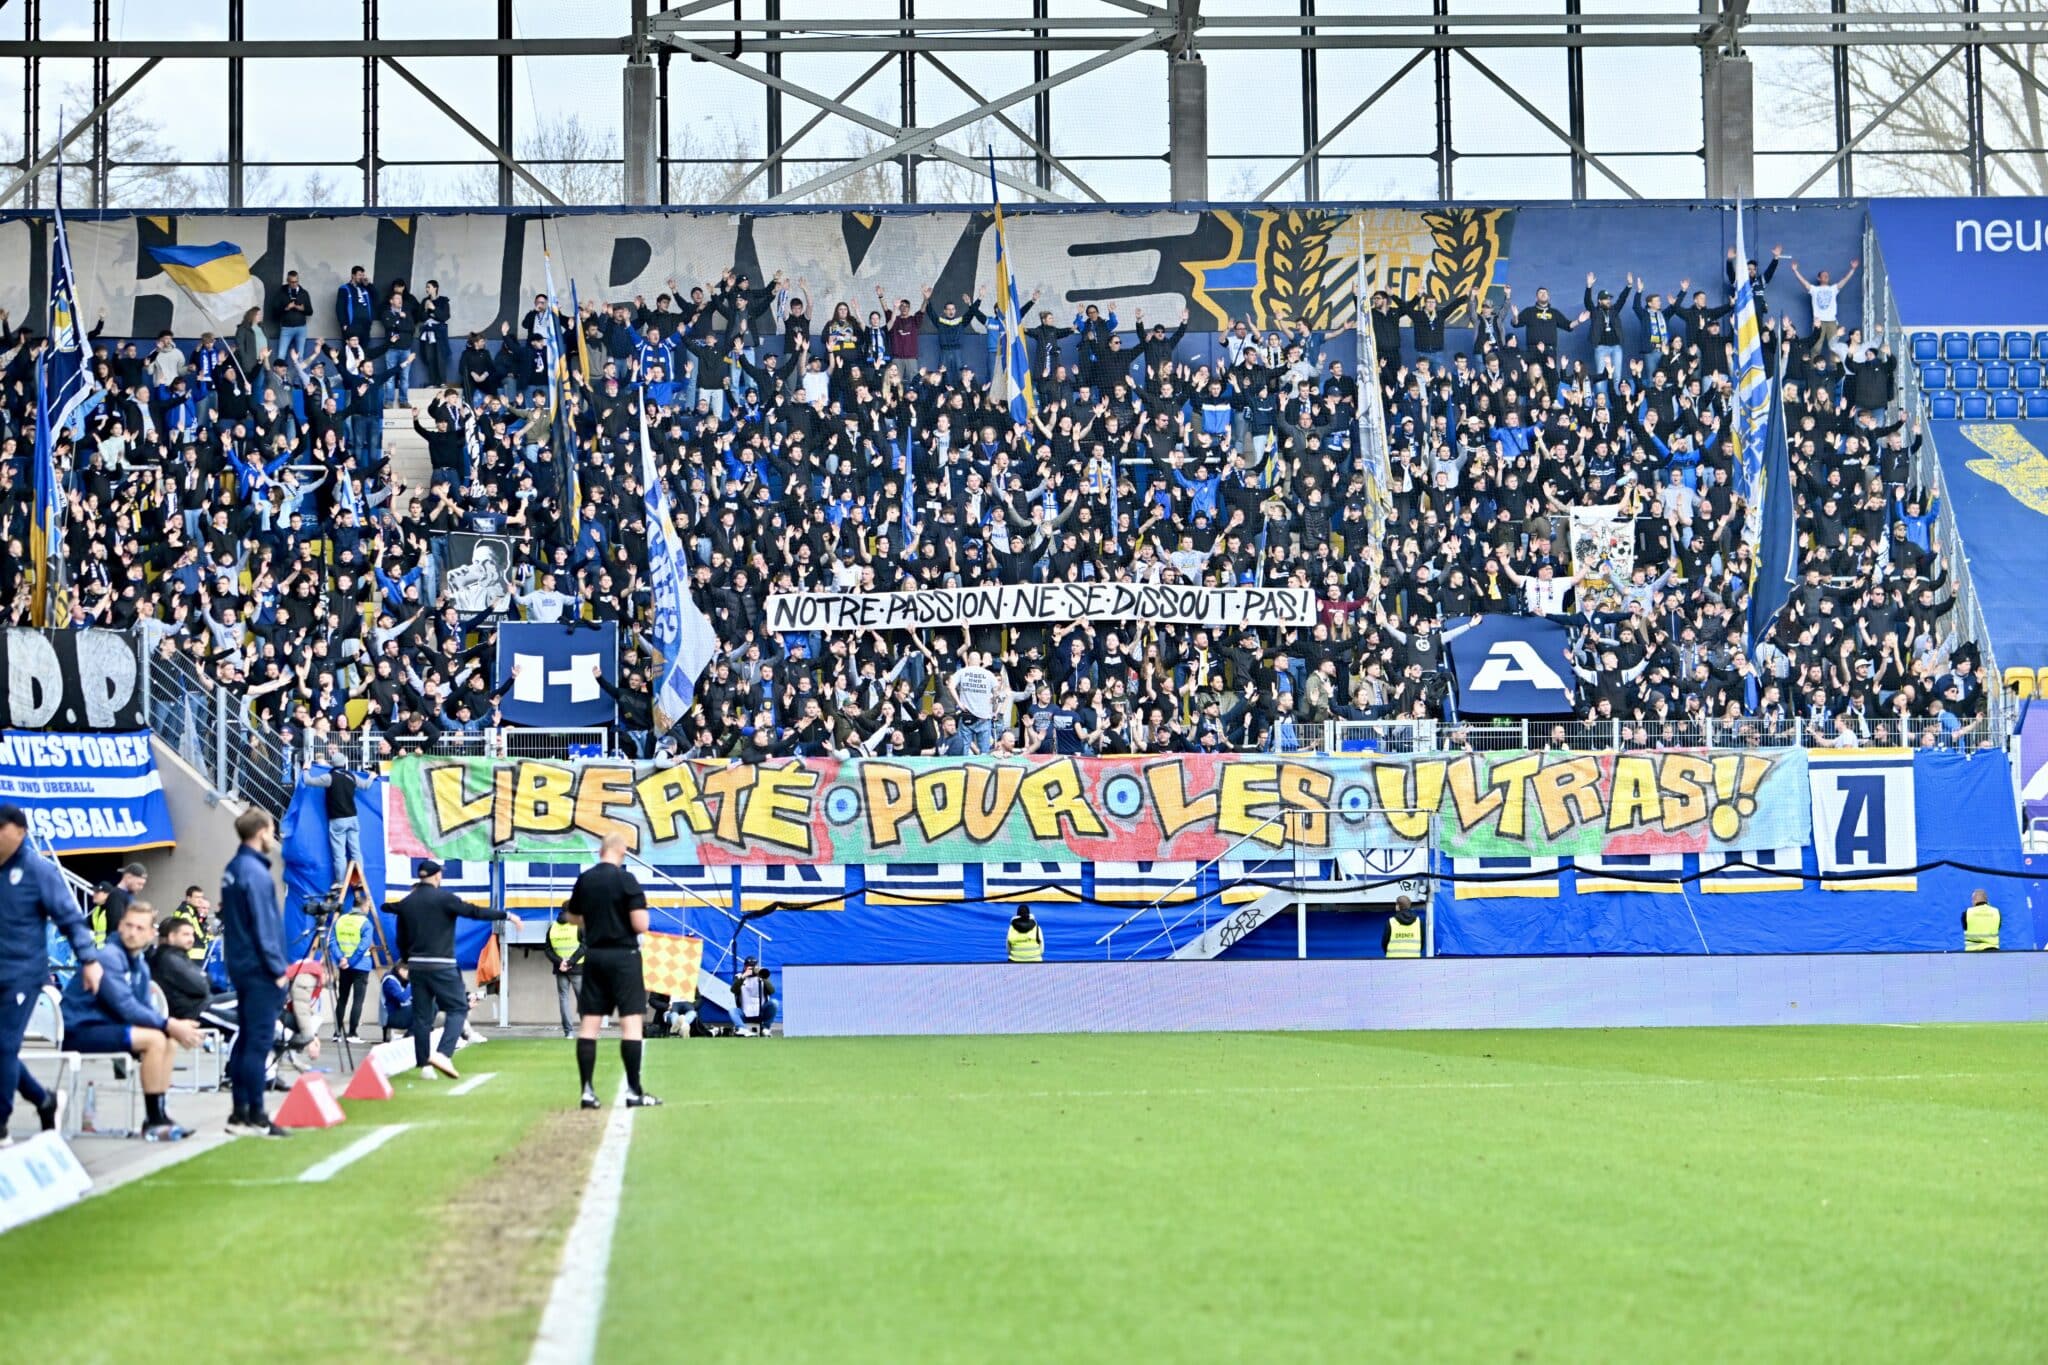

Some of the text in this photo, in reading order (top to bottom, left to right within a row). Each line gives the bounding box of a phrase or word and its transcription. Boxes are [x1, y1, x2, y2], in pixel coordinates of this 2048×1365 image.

[1955, 219, 2048, 252] neu
[0, 214, 1200, 336] KURVE
[774, 583, 1309, 628] NOTRE PASSION NE SE DISSOUT PAS!
[18, 781, 41, 794] UND
[44, 780, 95, 794] ÜBERALL
[427, 753, 1773, 857] LIBERTÉ POUR LES ULTRAS!!
